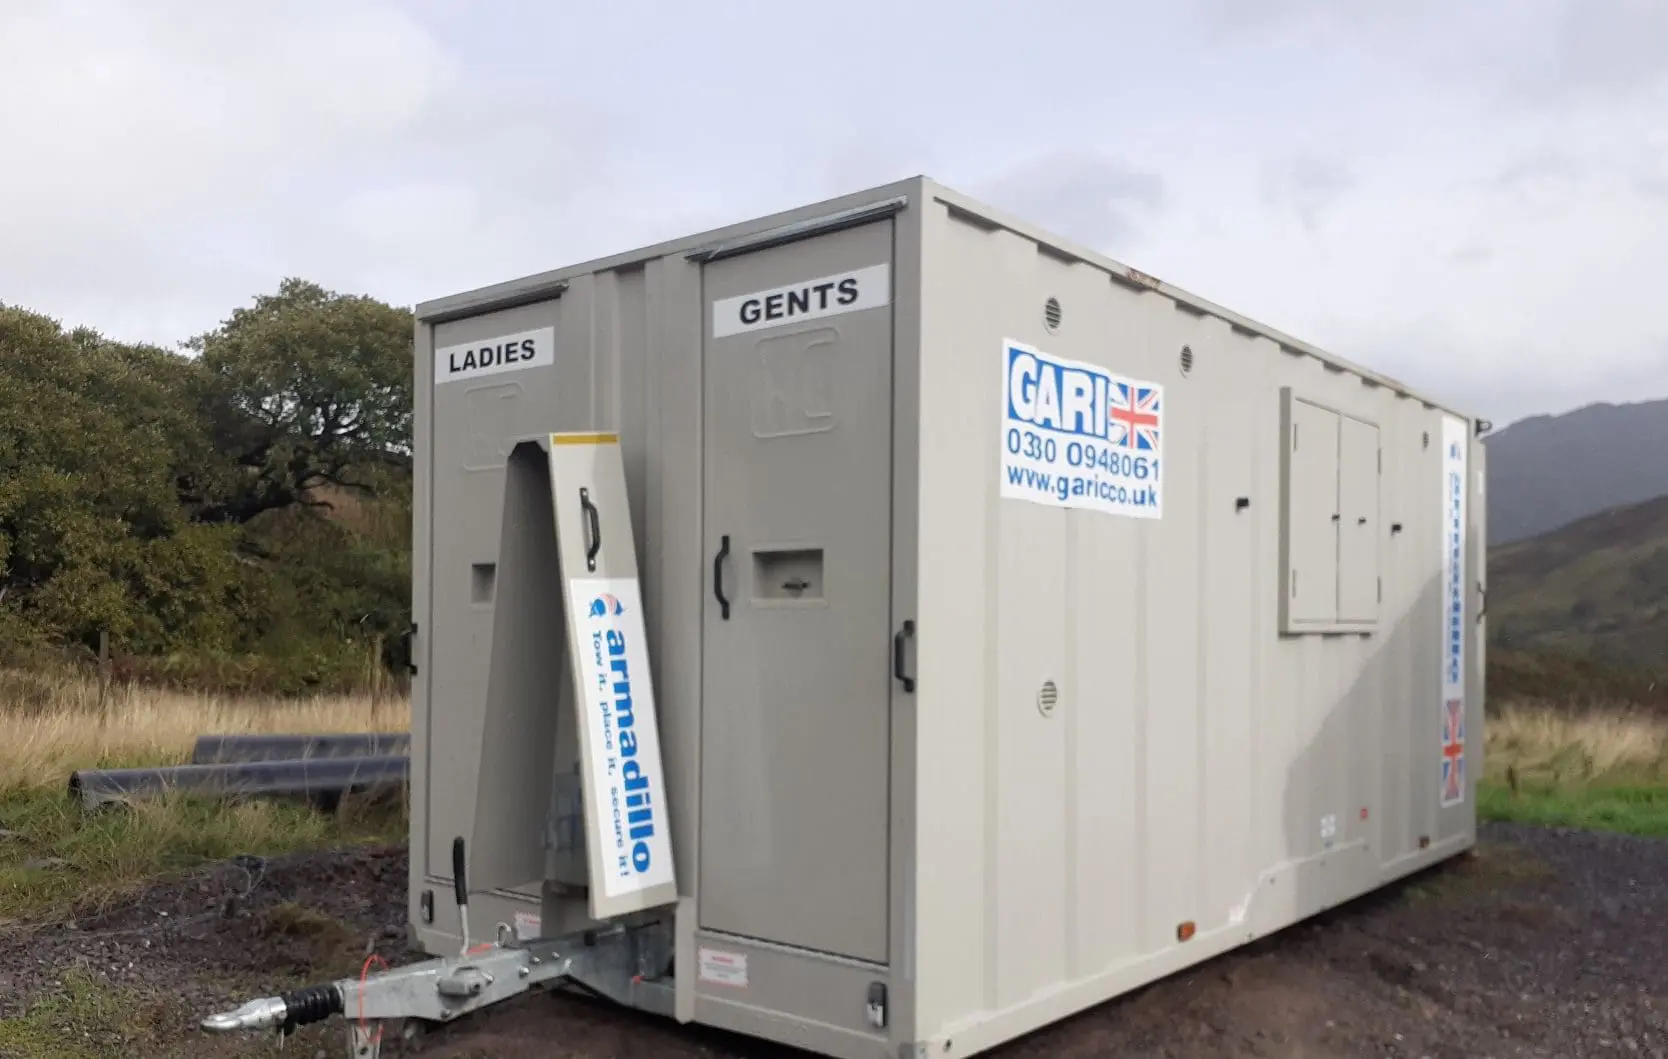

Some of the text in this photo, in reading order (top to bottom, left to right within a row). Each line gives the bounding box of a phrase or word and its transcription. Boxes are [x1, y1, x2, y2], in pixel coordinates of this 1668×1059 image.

[739, 278, 859, 326] GENTS
[448, 339, 536, 373] LADIES
[1008, 428, 1160, 481] 0330 0948061
[592, 631, 604, 667] Tow
[599, 701, 613, 750] place
[611, 786, 625, 849] secure
[606, 629, 655, 873] armadillo
